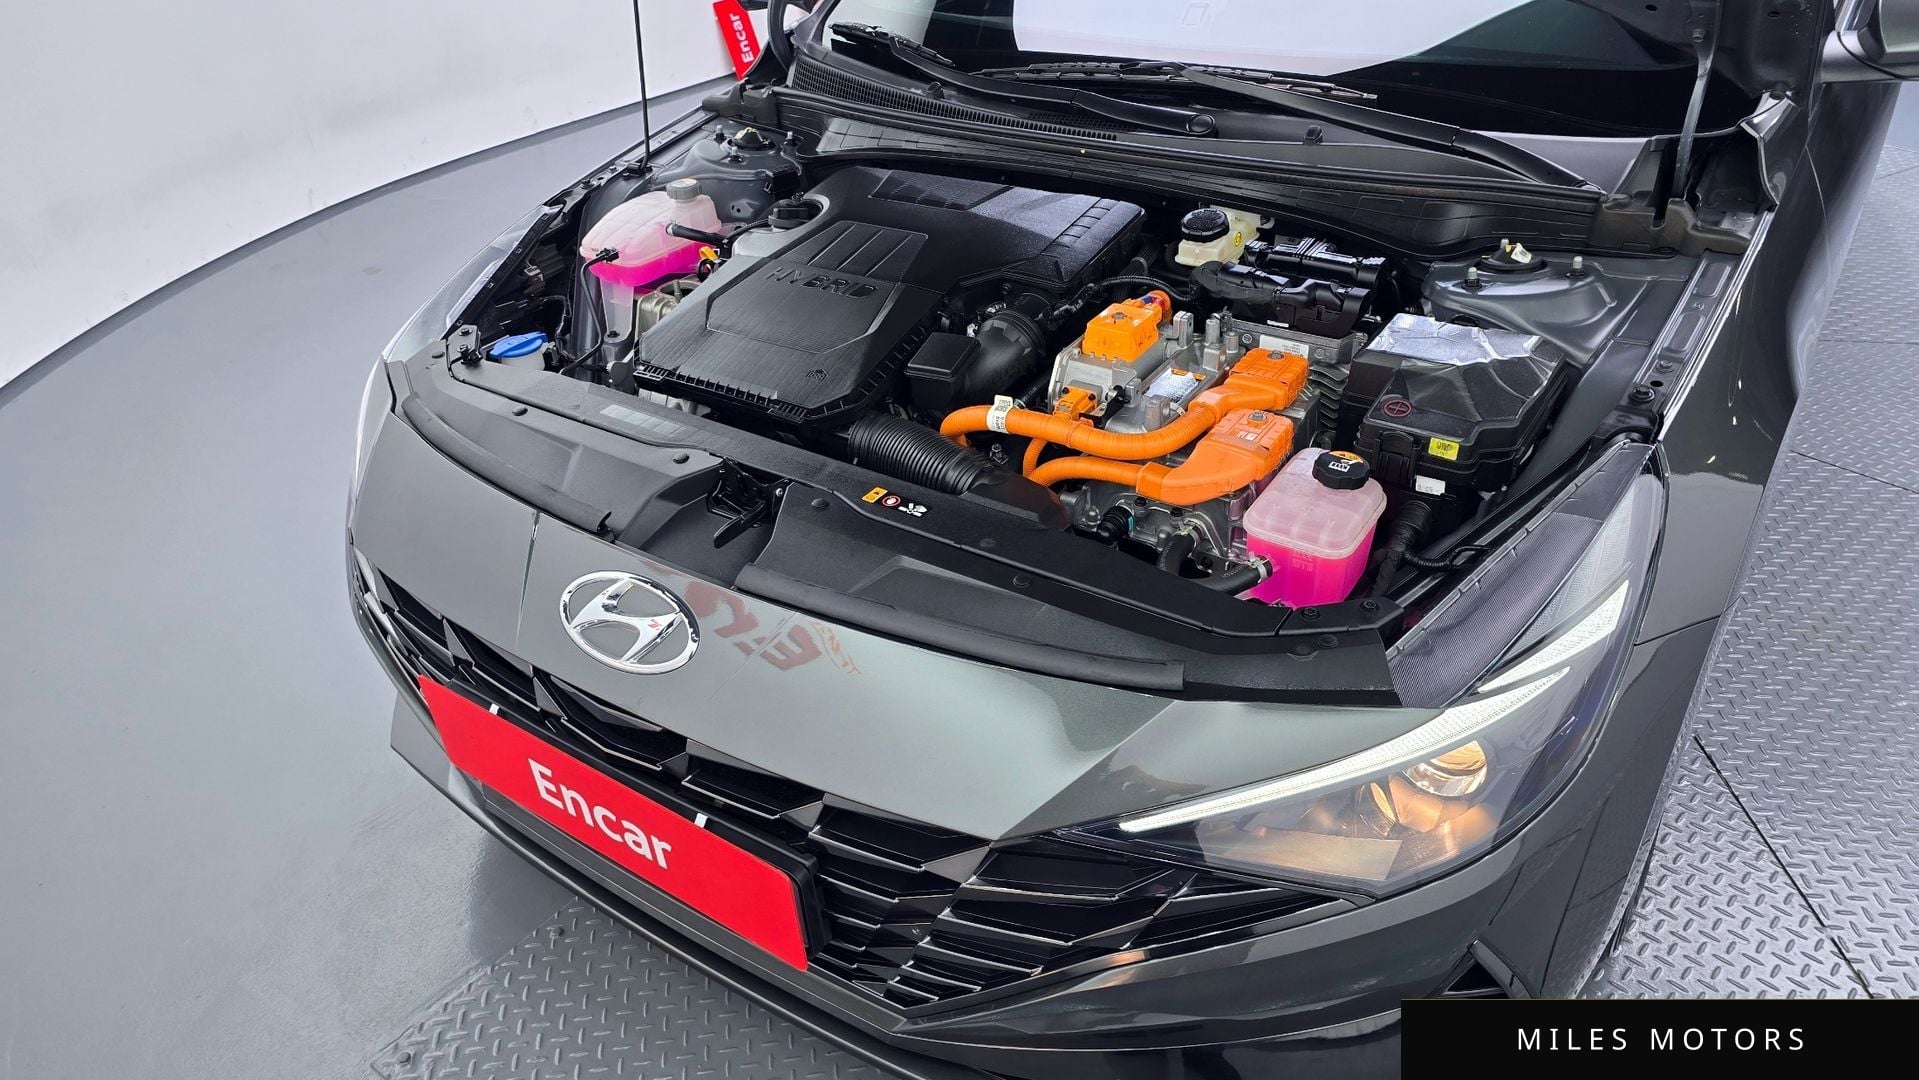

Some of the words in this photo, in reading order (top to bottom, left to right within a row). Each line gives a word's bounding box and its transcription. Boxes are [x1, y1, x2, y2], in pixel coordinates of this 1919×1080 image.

[729, 13, 754, 63] Encar
[766, 267, 879, 299] HYBRID
[528, 759, 672, 869] Encar
